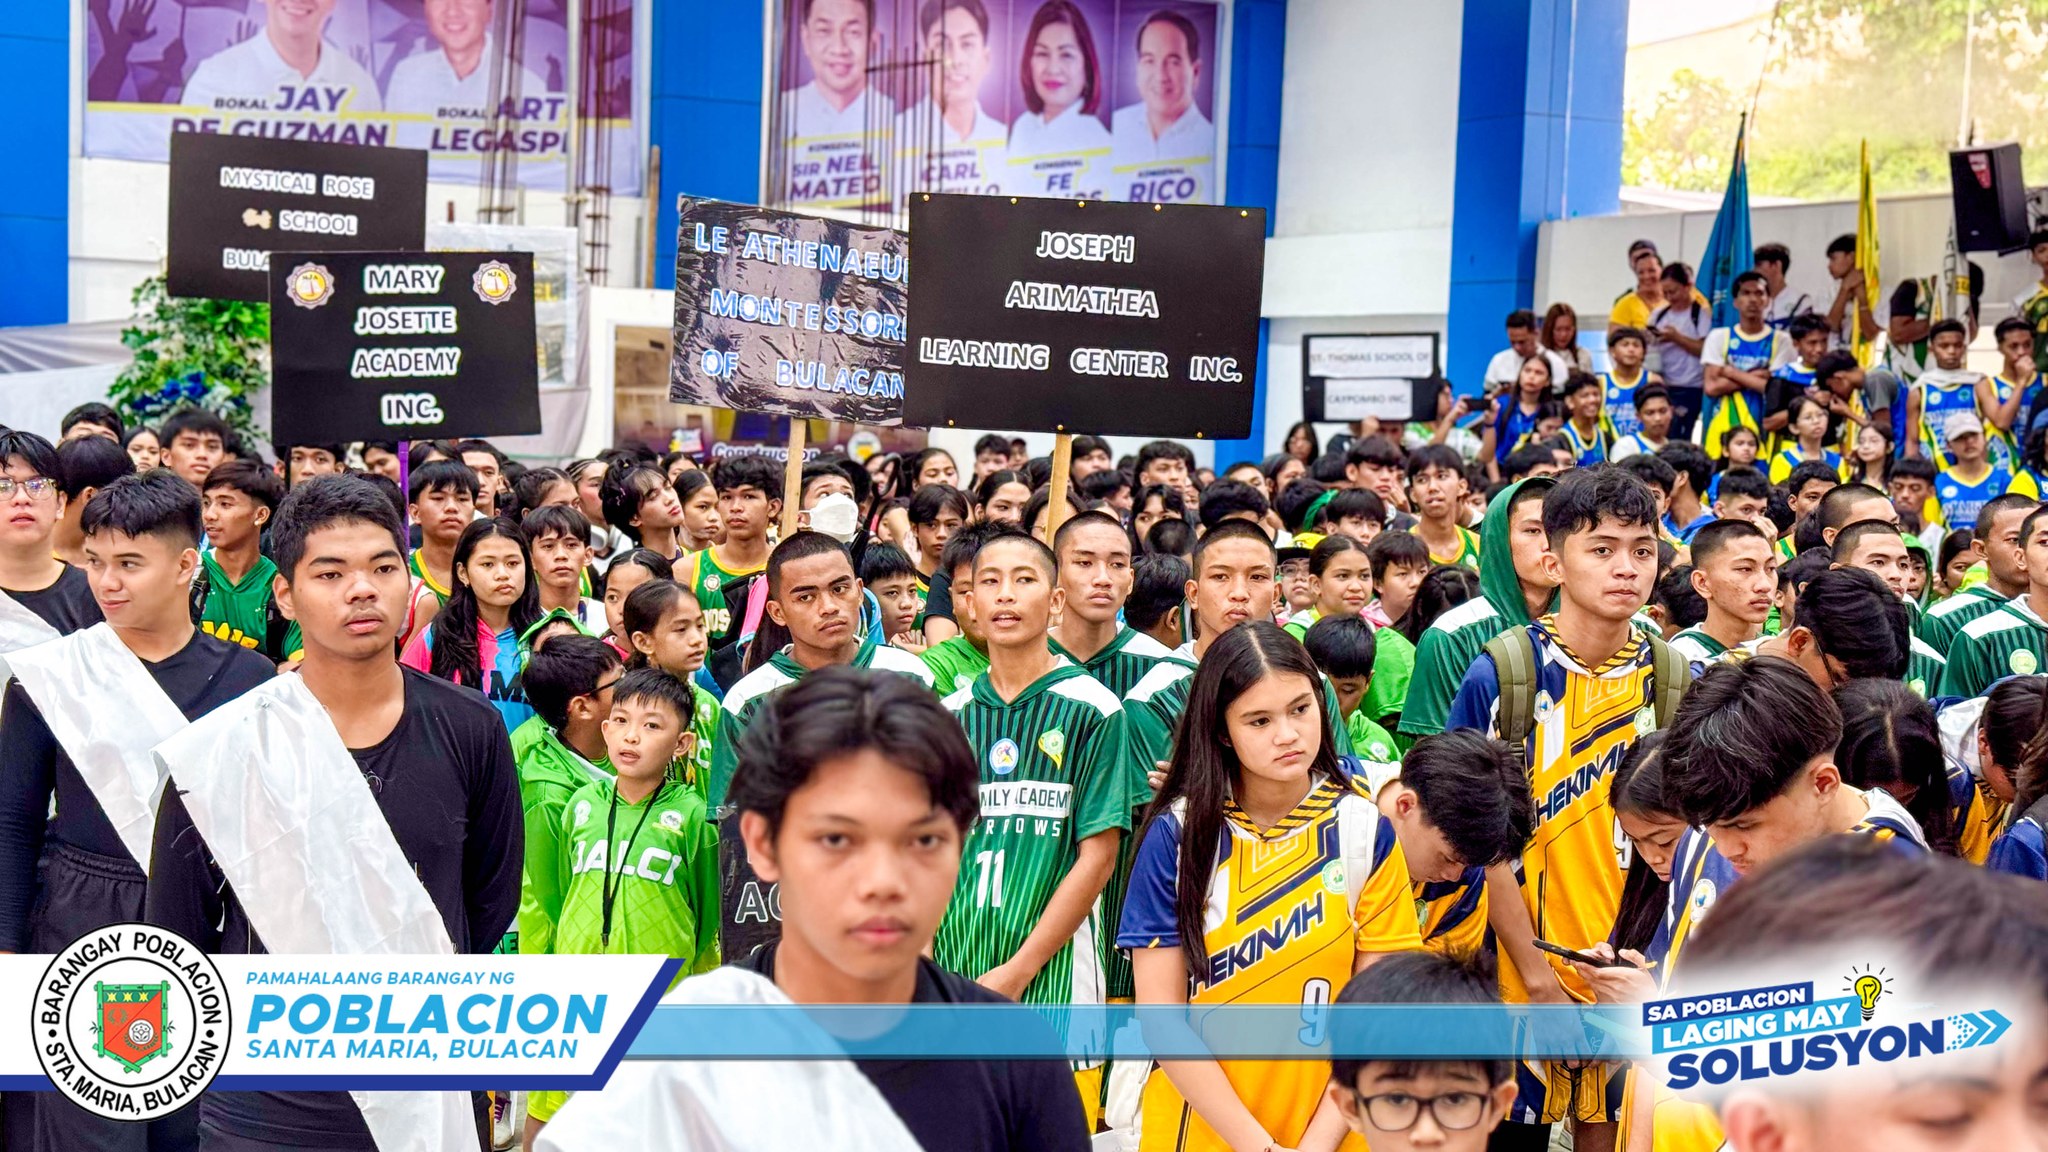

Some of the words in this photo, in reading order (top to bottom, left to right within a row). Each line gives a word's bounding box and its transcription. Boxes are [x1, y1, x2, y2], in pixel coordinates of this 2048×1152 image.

[214, 97, 269, 110] BOKAL
[274, 86, 347, 112] JAY
[437, 107, 488, 119] BOKAL
[494, 97, 565, 121] ART
[231, 119, 388, 147] GUZMAN
[221, 168, 315, 193] MYSTICAL
[323, 176, 374, 198] ROSE
[792, 163, 820, 178] SIR
[921, 162, 981, 182] CARL
[1047, 173, 1072, 191] FE
[791, 175, 882, 199] MATEO
[1129, 177, 1196, 202] RICO
[280, 211, 357, 235] SCHOOL
[695, 223, 727, 254] LE
[1036, 231, 1135, 263] JOSEPH
[364, 265, 444, 293] MARY
[1005, 281, 1160, 318] ARIMATHEA
[355, 306, 457, 334] JOSETTE
[352, 347, 460, 378] ACADEMY
[919, 337, 1050, 370] LEARNING
[1070, 348, 1169, 378] CENTER
[1189, 356, 1243, 382] INC.
[1328, 352, 1372, 363] THOMAS
[1374, 352, 1414, 363] SCHOOL
[1416, 352, 1430, 362] OF
[701, 348, 739, 378] OF
[775, 359, 905, 400] BULACAN
[382, 393, 444, 424] INC.
[711, 442, 822, 462] Construcon
[1014, 787, 1071, 809] CADEM
[976, 848, 1005, 908] 11
[1298, 976, 1332, 1048] 9
